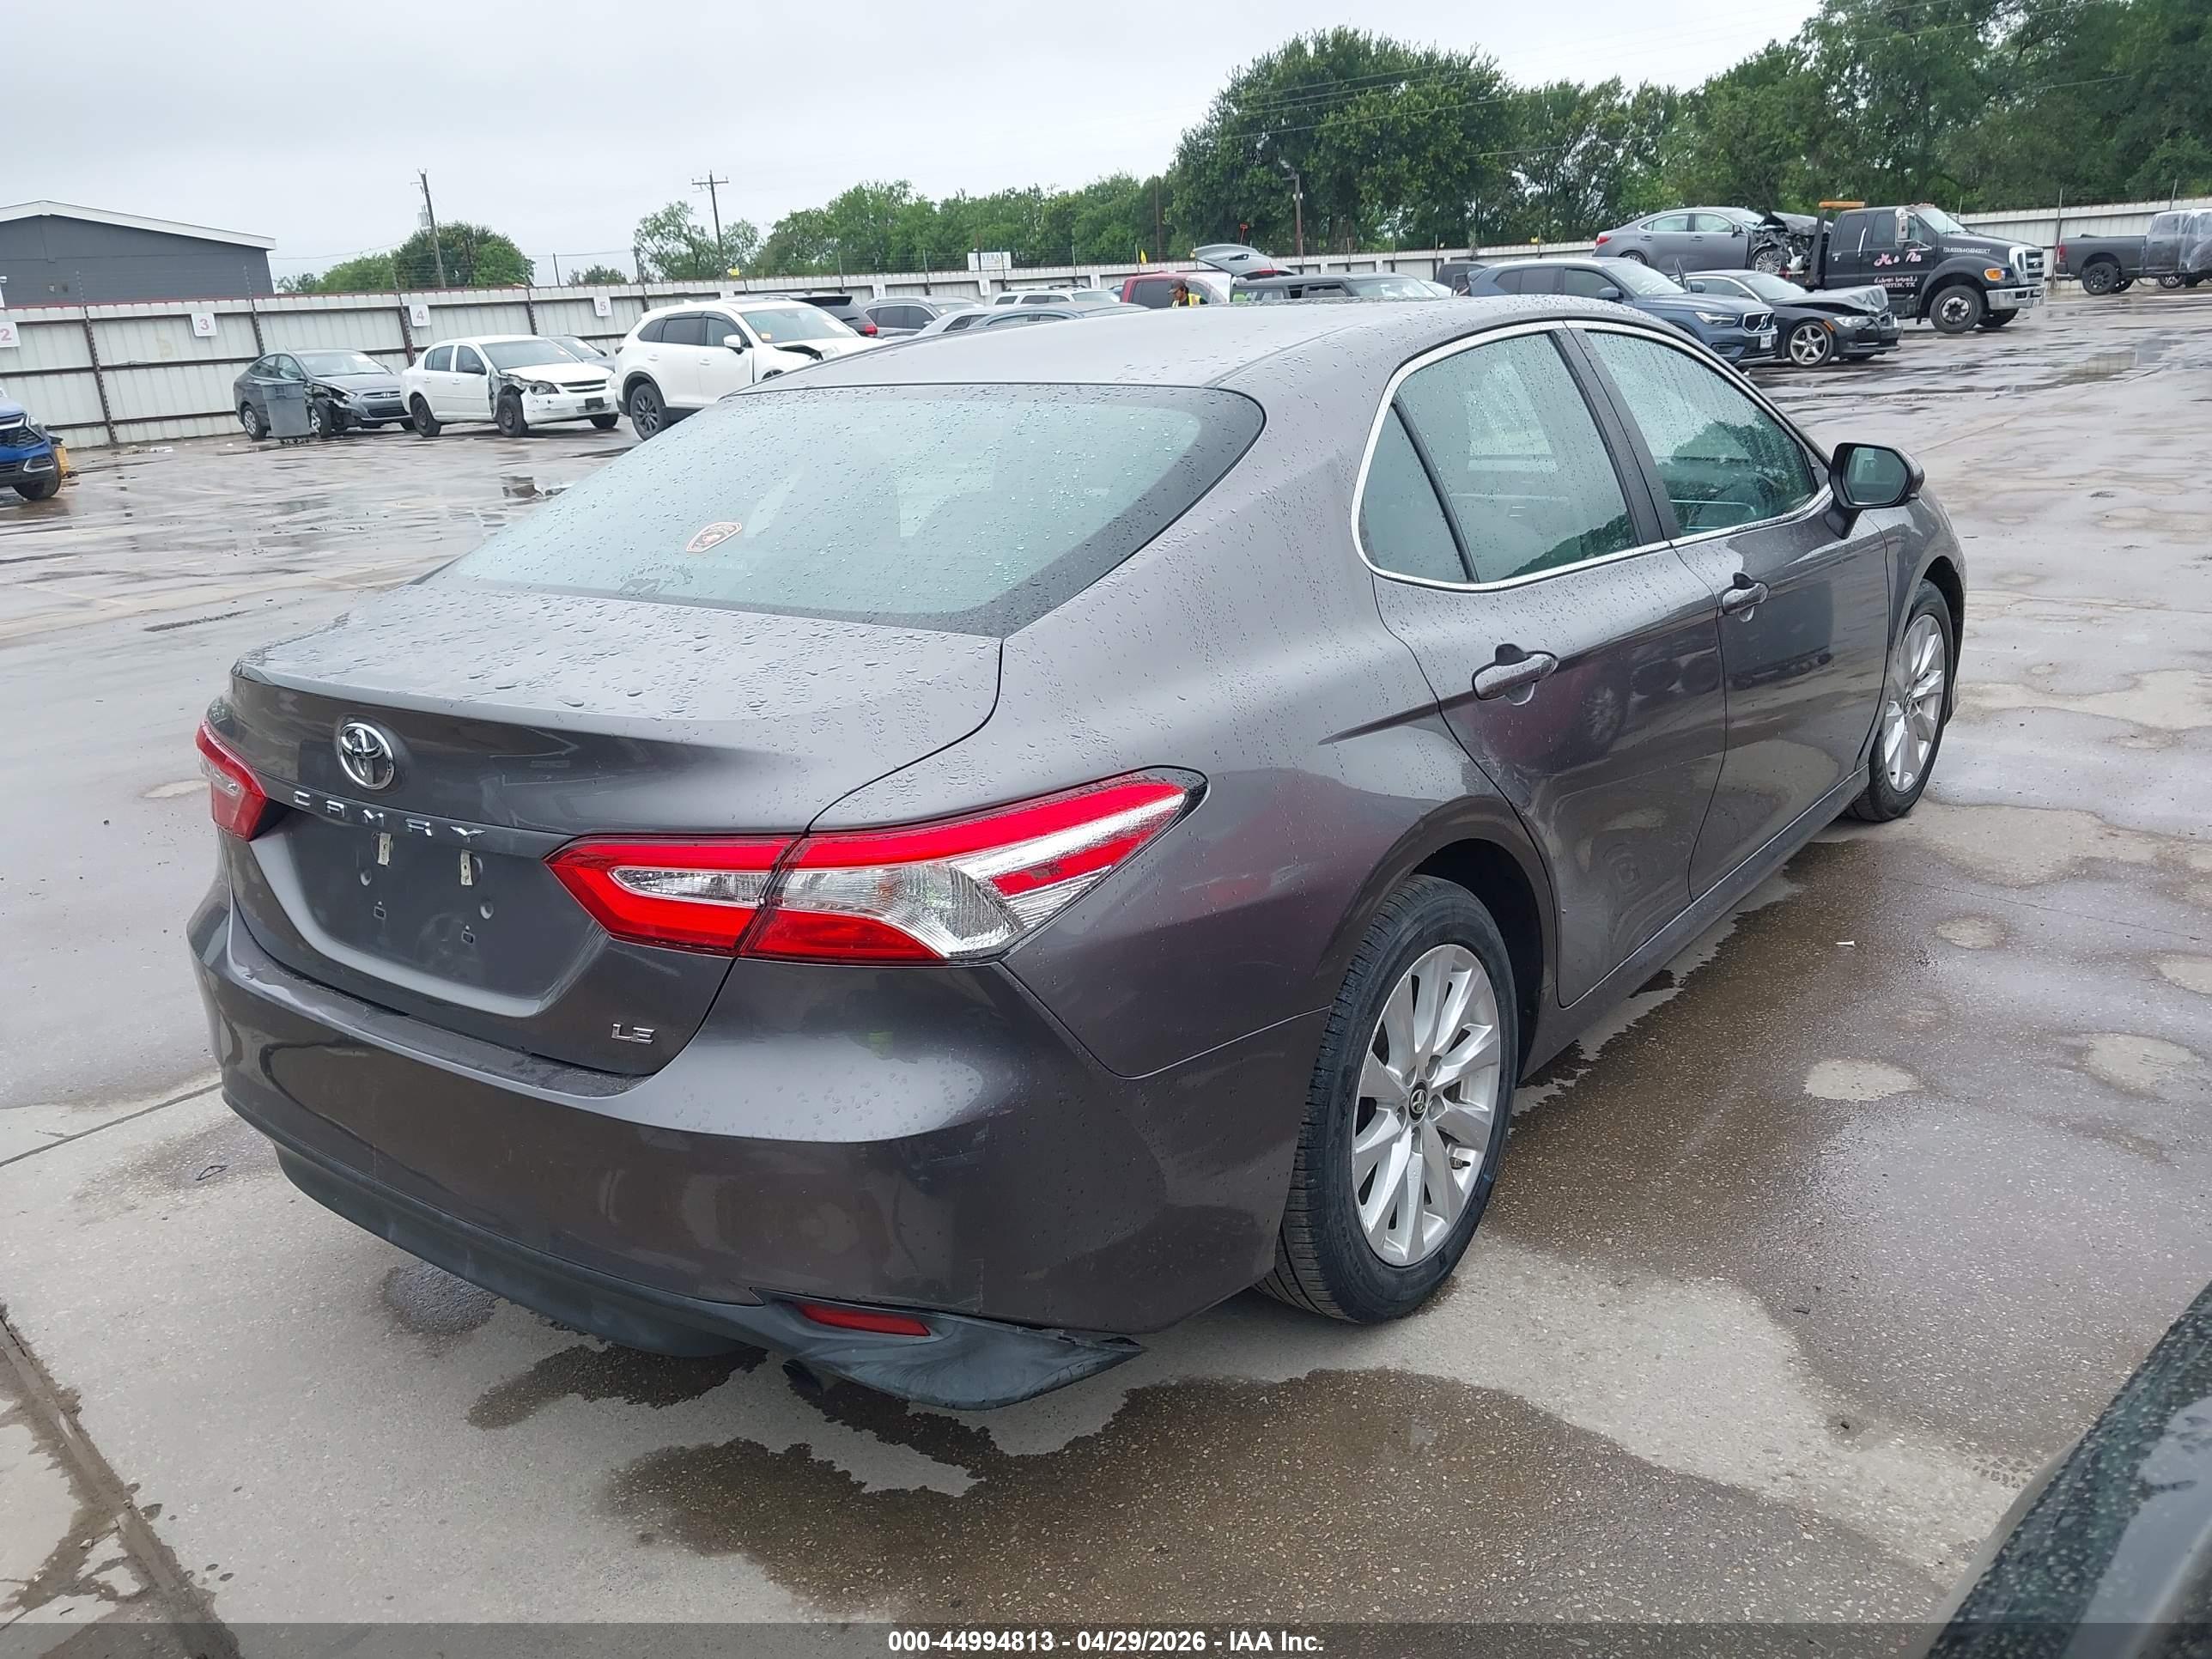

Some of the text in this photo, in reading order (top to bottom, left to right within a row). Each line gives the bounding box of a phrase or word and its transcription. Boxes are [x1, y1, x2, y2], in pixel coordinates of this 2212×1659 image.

[599, 301, 607, 312] 5
[416, 310, 425, 321] 4
[198, 318, 210, 331] 3
[0, 328, 12, 342] 2
[293, 789, 486, 844] CAMRY
[611, 1023, 655, 1045] LE
